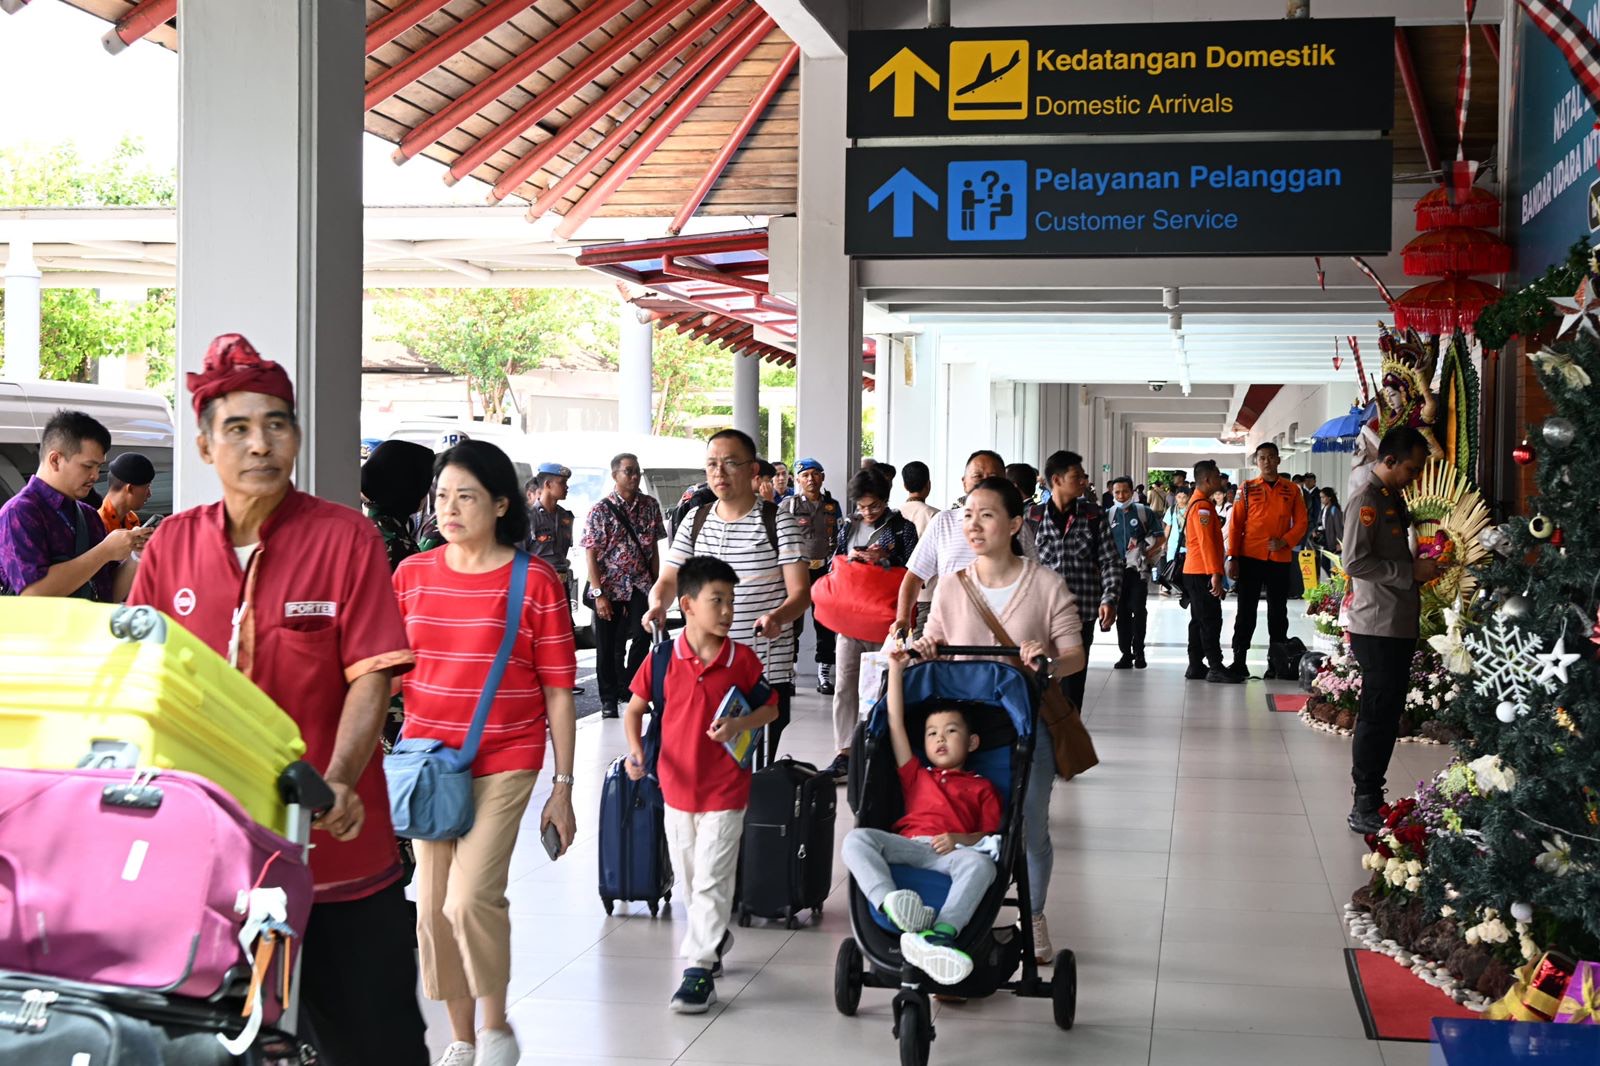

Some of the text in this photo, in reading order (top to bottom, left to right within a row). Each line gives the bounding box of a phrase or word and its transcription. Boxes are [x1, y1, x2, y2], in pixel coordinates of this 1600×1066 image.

[1036, 43, 1336, 75] Kedatangan Domestik
[1036, 93, 1234, 116] Domestic Arrivals
[1553, 84, 1583, 144] NATAL
[1035, 165, 1342, 196] Pelayanan Pelanggan
[1521, 171, 1552, 225] BANDAR
[1553, 143, 1582, 199] UDARA
[1036, 209, 1239, 232] Customer Service
